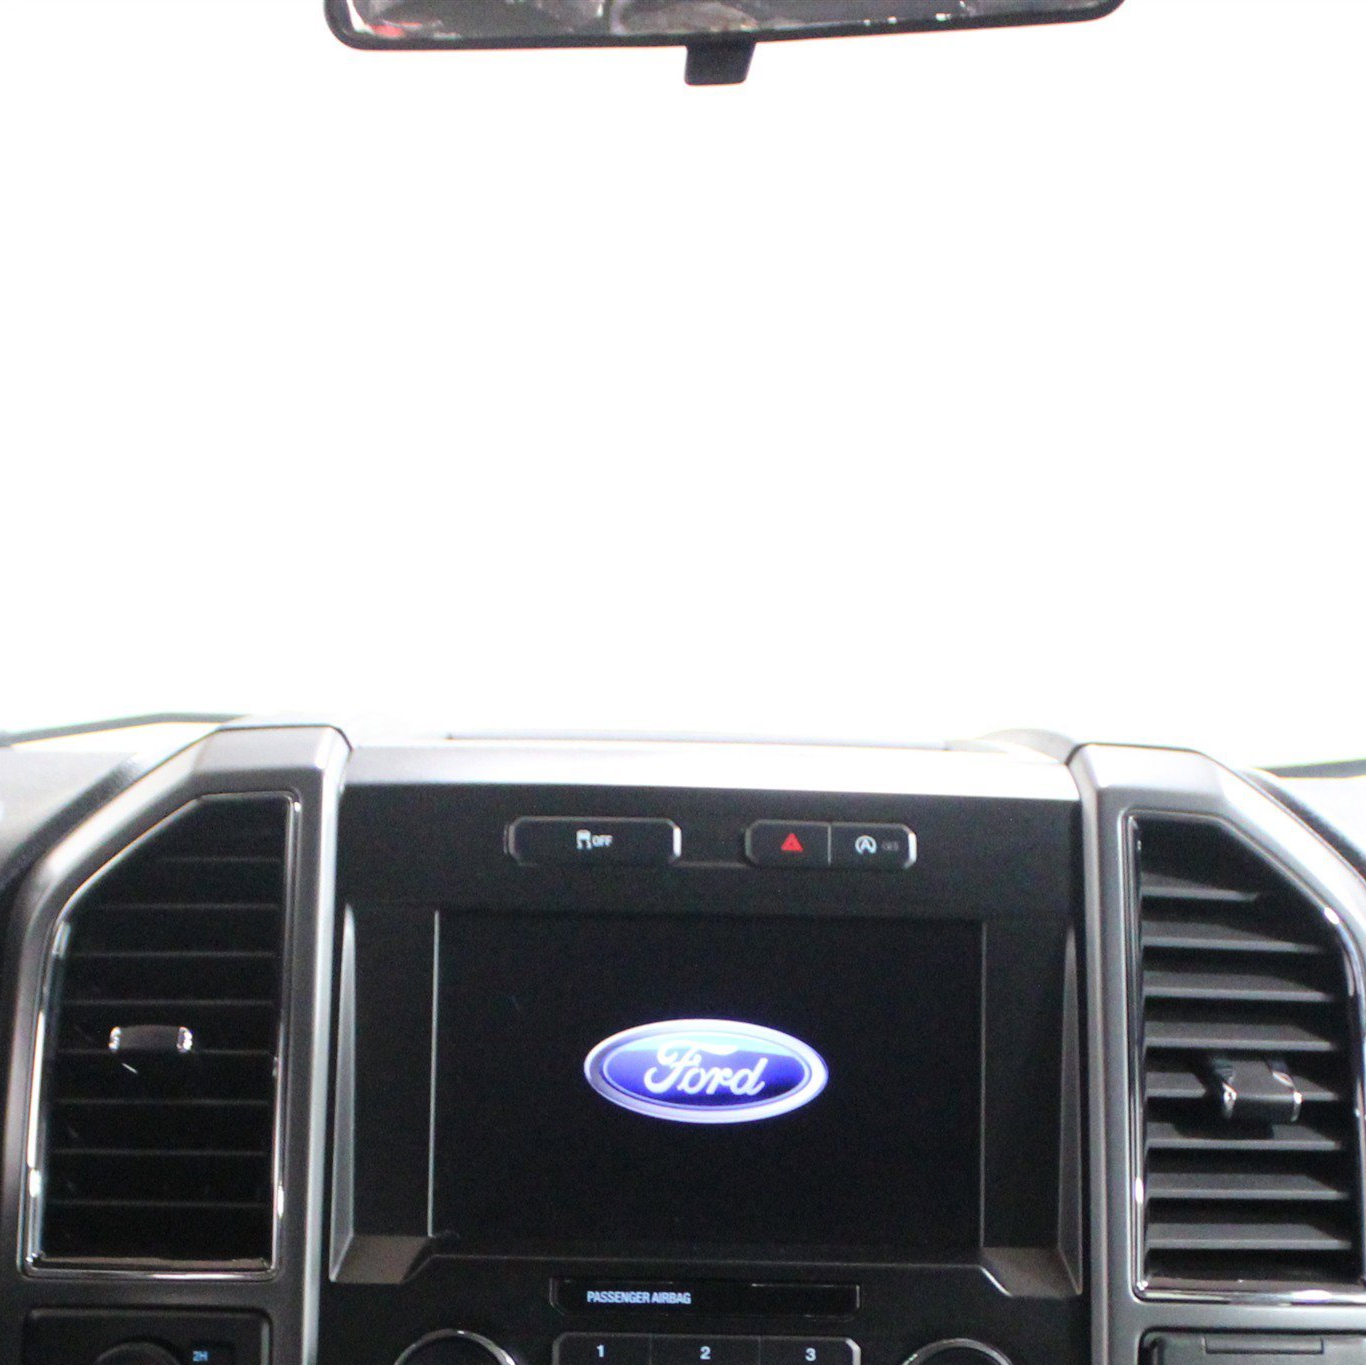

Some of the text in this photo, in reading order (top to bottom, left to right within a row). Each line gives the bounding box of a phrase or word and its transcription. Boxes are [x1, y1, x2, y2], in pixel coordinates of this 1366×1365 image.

[592, 834, 613, 847] OFF
[644, 1040, 768, 1096] Ford
[586, 1290, 692, 1304] PASSENGER AIRBAG
[192, 1351, 209, 1362] 2H
[596, 1344, 604, 1357] 1
[699, 1346, 711, 1360] 2
[804, 1348, 816, 1362] 3
